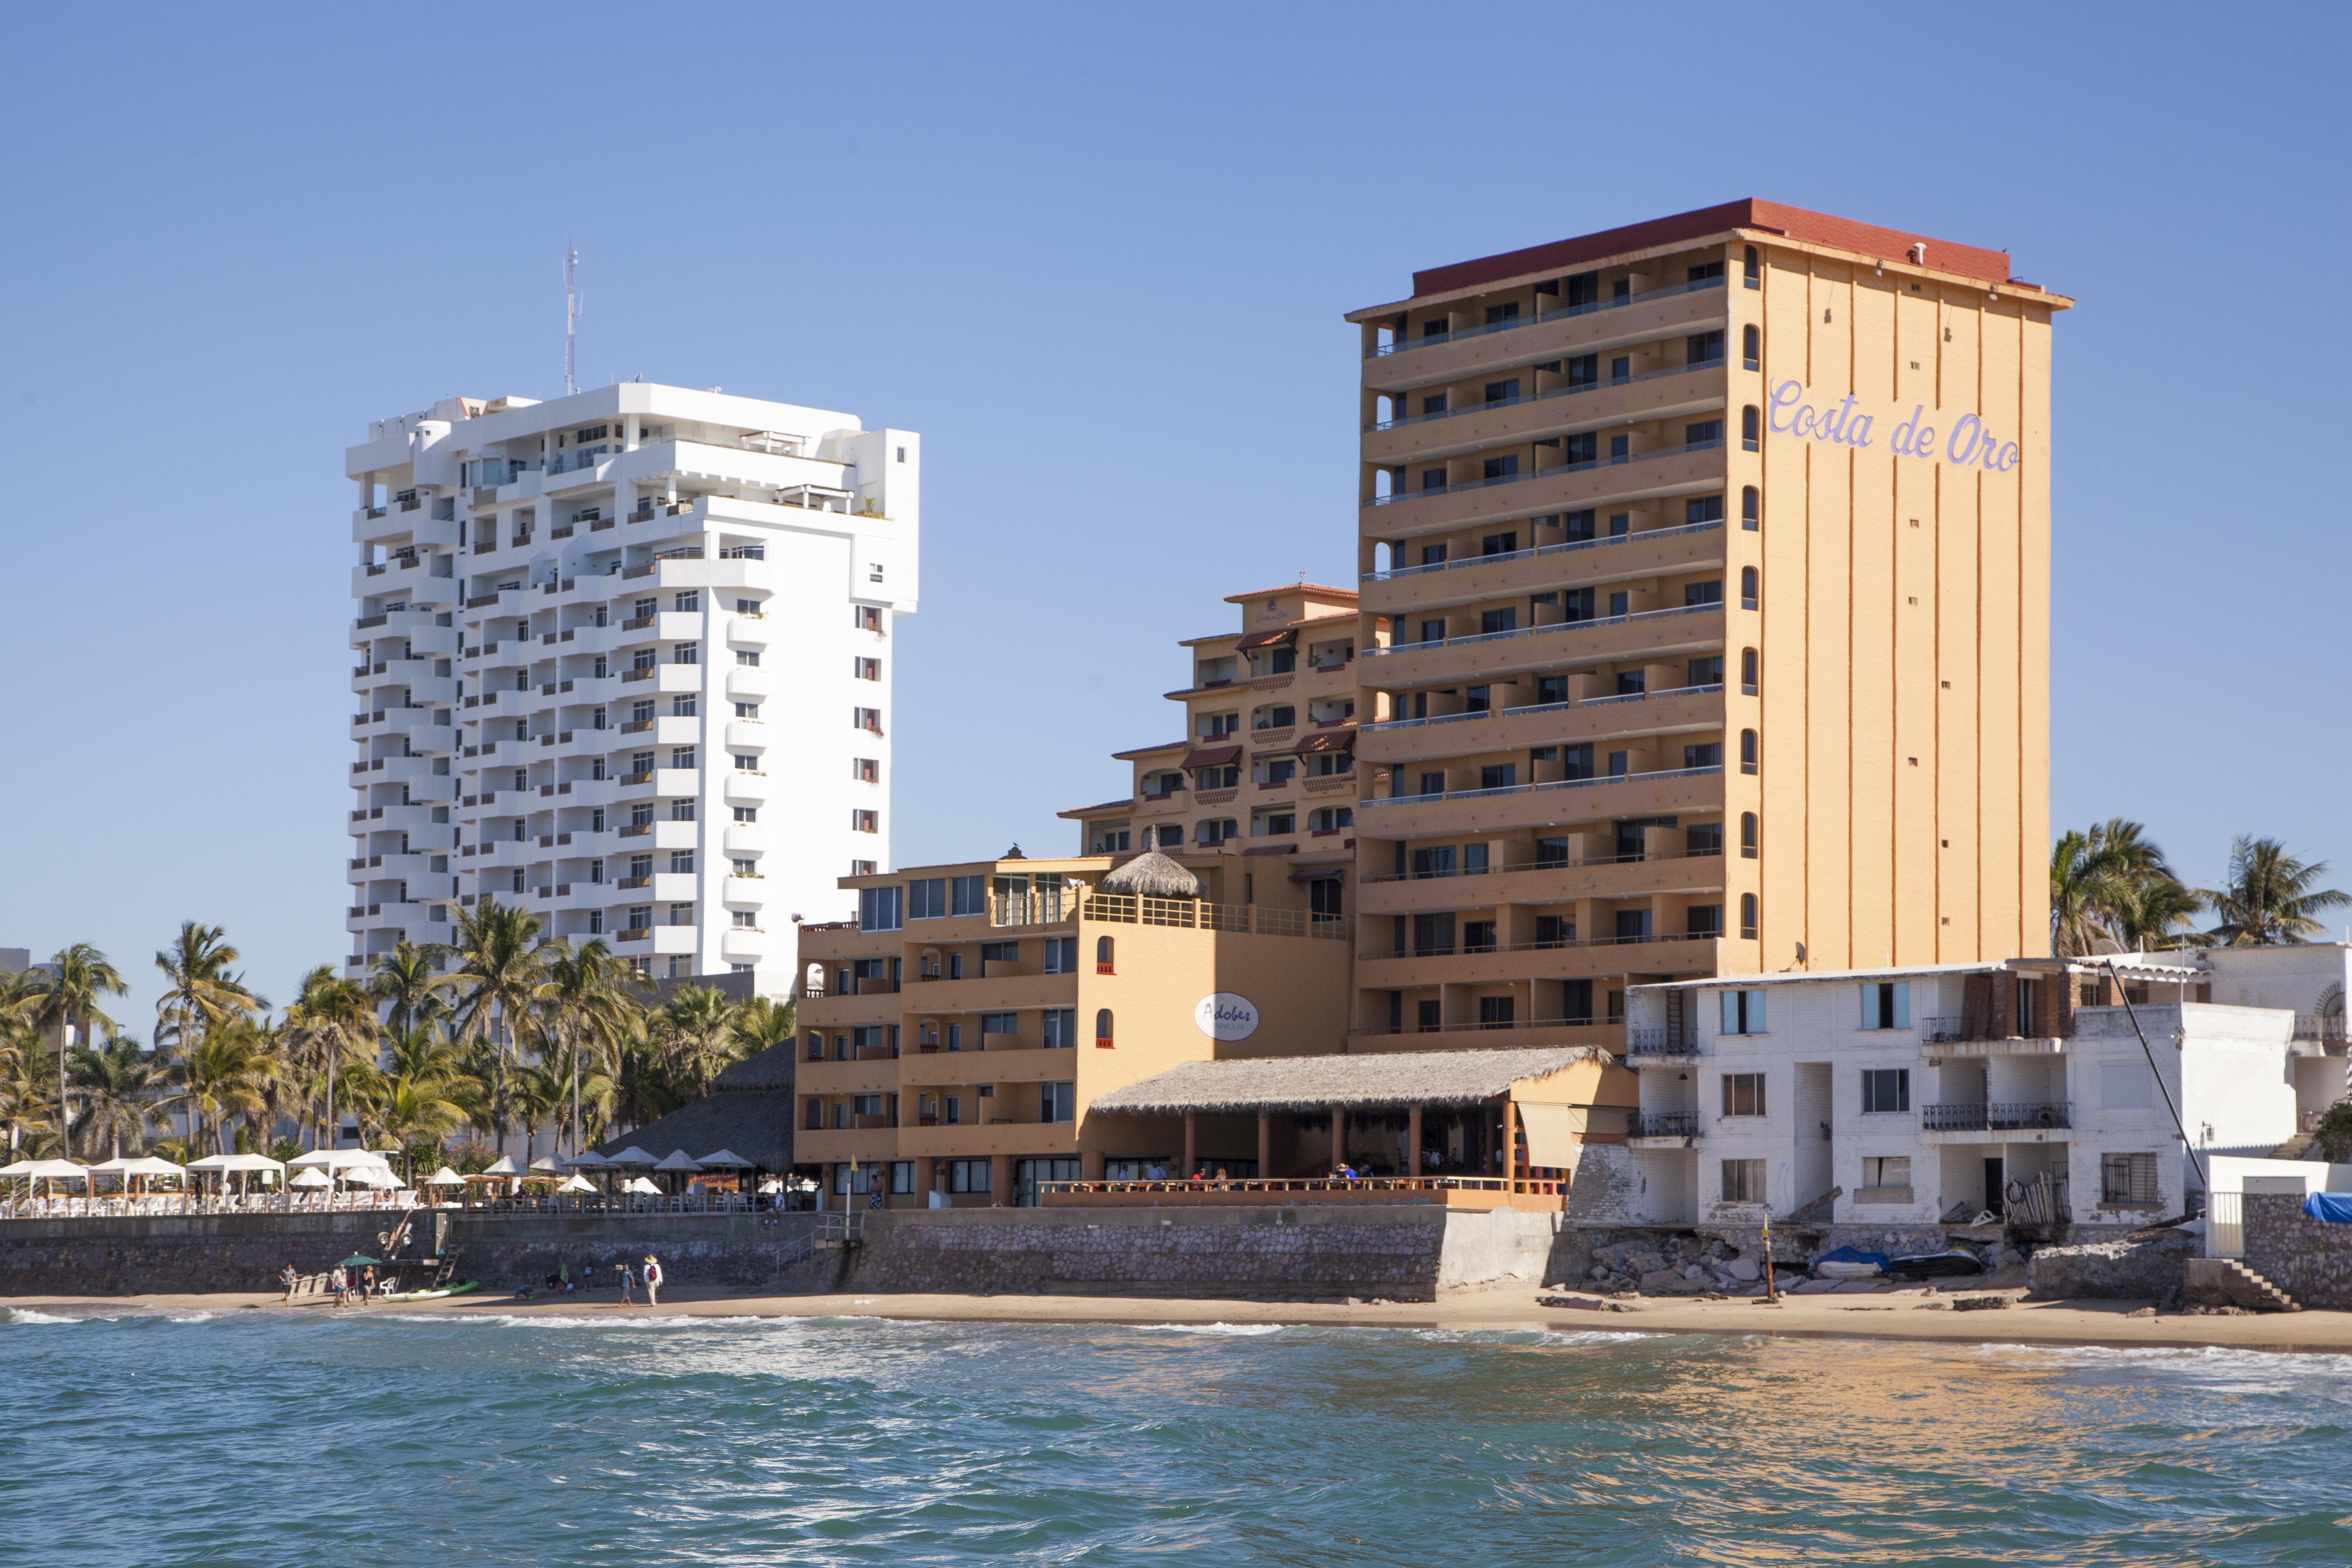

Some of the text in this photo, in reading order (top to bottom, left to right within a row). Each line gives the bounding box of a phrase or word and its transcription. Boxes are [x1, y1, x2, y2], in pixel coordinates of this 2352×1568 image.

[1769, 377, 2020, 472] Costa de Oro
[1203, 1003, 1251, 1022] Adobes
